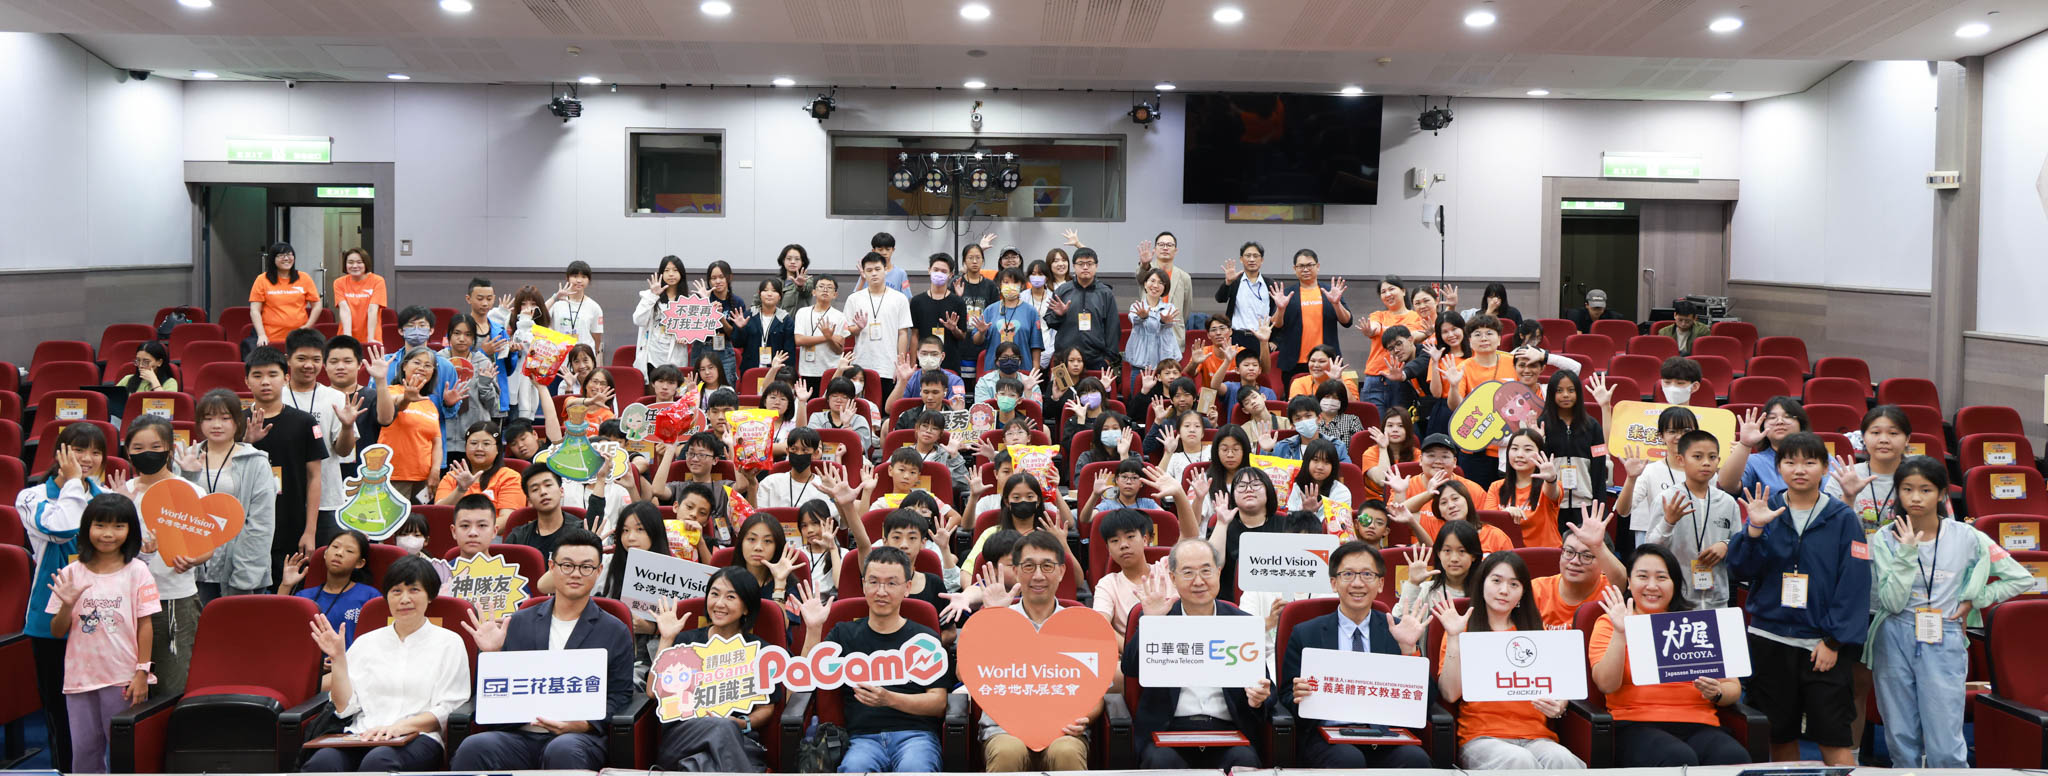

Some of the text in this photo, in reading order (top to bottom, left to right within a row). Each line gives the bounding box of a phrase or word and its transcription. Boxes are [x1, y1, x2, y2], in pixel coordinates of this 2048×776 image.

[675, 305, 712, 316] 不要再
[667, 318, 716, 330] 打我土地
[1249, 556, 1318, 566] World Vision
[635, 566, 676, 585] World
[451, 575, 512, 597] 神隊友
[1145, 642, 1205, 656] 中華電信
[705, 648, 746, 670] 請叫我
[1145, 657, 1179, 665] Chunghwa
[977, 664, 1081, 679] World Vision
[1665, 667, 1719, 678] Japanese Restaurant
[511, 675, 601, 695] 三花基金會
[693, 676, 757, 709] 知識王
[1322, 682, 1424, 701] 義美體育文教基金會
